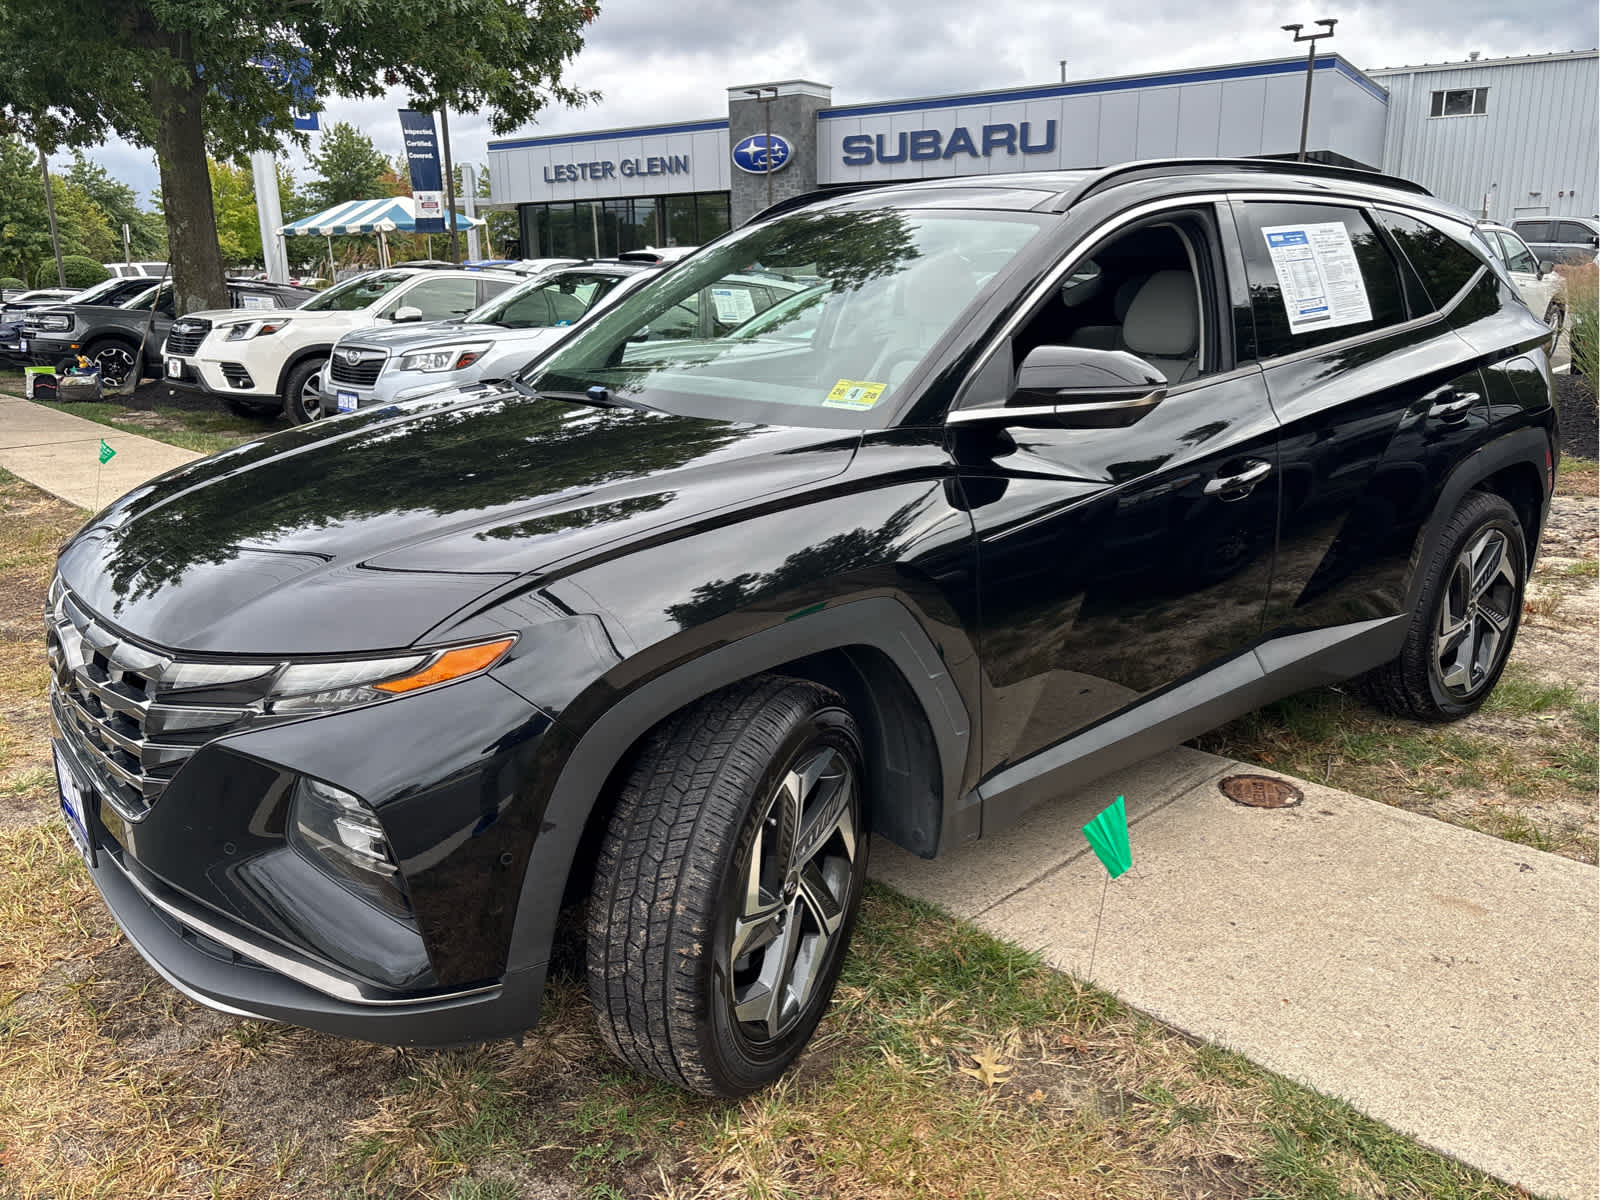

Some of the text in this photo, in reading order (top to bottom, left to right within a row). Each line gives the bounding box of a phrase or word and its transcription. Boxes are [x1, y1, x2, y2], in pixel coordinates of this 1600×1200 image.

[404, 128, 434, 136] Inspected.
[842, 119, 1057, 166] SUBARU
[543, 154, 689, 184] LESTER GLENN
